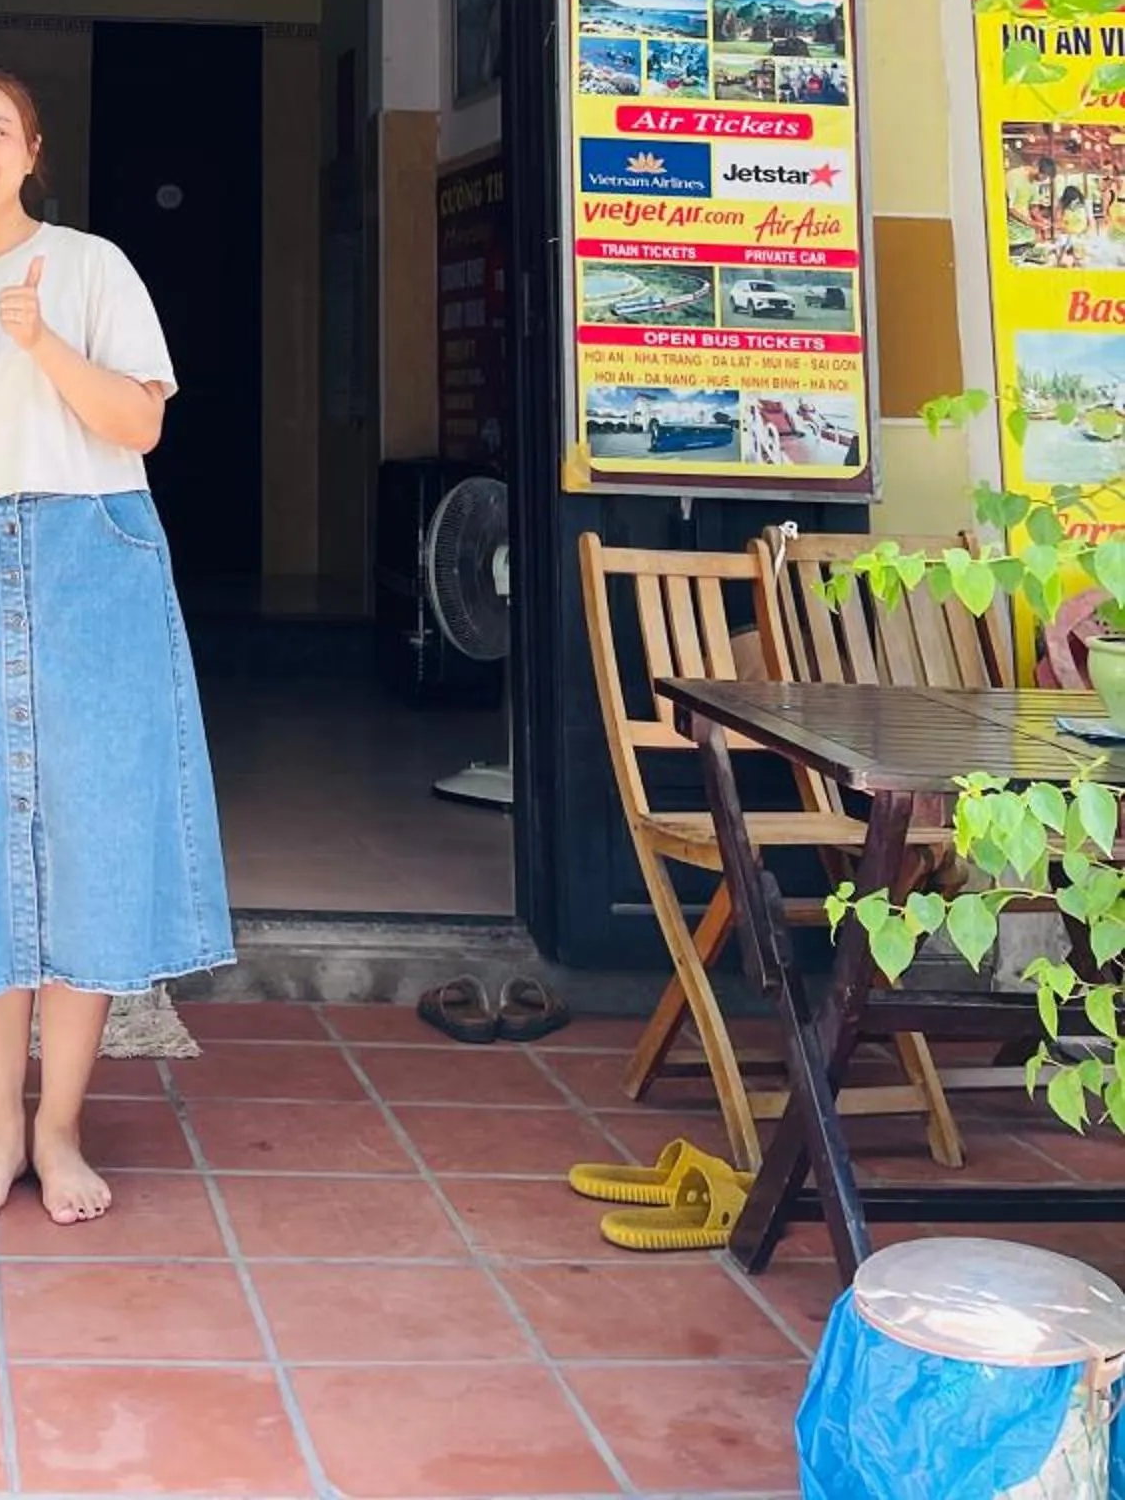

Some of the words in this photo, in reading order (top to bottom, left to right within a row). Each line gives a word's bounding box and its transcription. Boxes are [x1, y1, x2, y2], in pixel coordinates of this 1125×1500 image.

[631, 111, 683, 131] Air
[693, 113, 801, 136] Tickets
[588, 172, 649, 188] Vietnam
[650, 176, 706, 190] Airlines
[723, 163, 812, 185] Jetstar
[600, 243, 639, 257] TRAIN
[641, 245, 697, 260] TICKETS
[744, 249, 796, 264] PRIVATE
[799, 251, 827, 264] CAR
[643, 331, 696, 346] OPEN
[701, 333, 740, 348] BUS
[746, 335, 826, 351] TICKETS
[608, 352, 624, 364] AN
[634, 352, 659, 364] NHA
[662, 353, 702, 366] TRANG
[712, 355, 728, 367] DA
[730, 356, 751, 367] LAT
[618, 372, 634, 384] AN
[644, 372, 660, 384] DA
[664, 373, 696, 386] NANG
